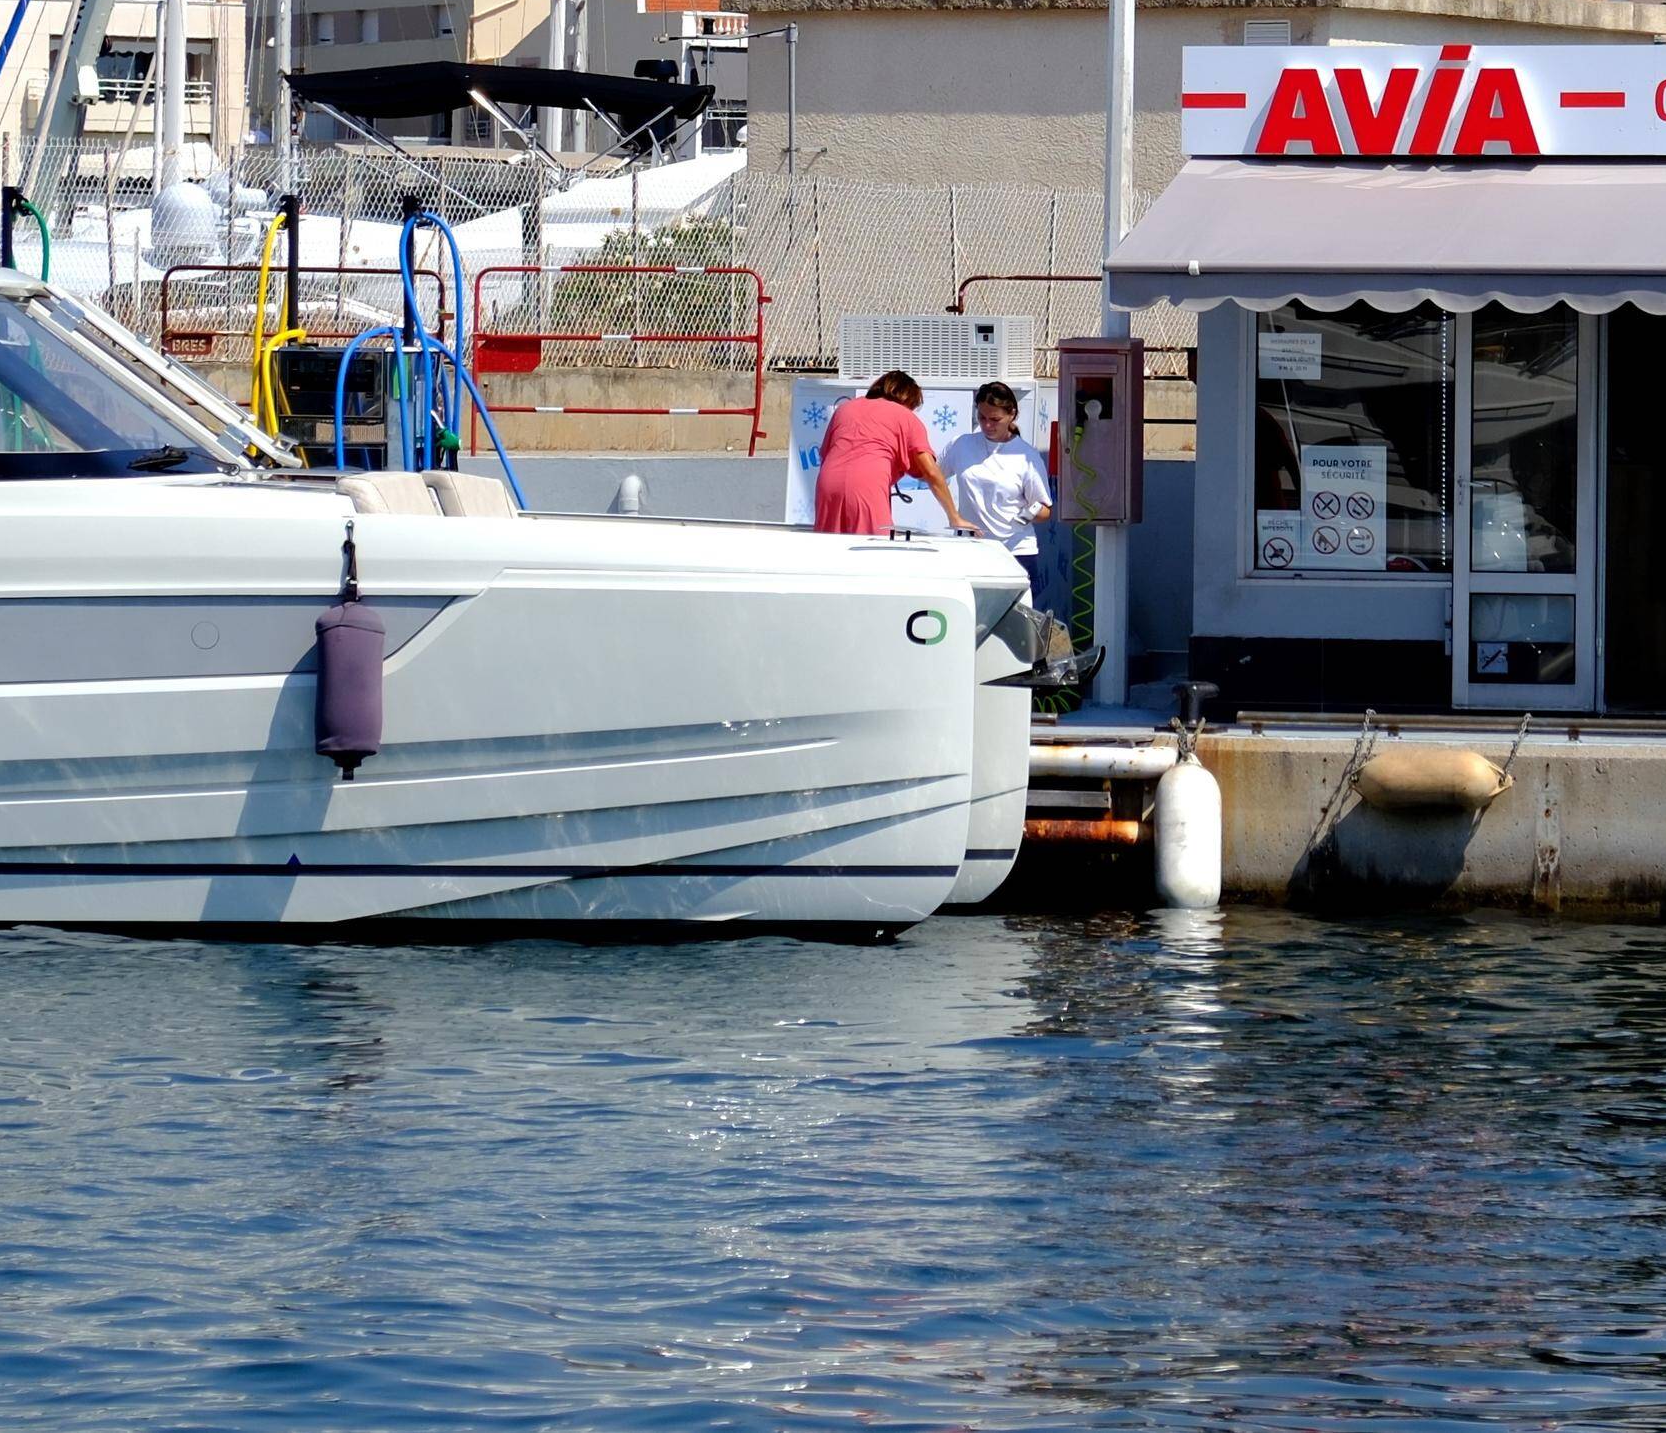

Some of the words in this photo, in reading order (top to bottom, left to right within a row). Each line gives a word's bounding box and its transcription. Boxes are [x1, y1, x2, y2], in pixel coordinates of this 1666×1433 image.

[172, 339, 206, 352] BRES
[1313, 459, 1339, 468] POUR
[1341, 459, 1372, 468] VOTRE
